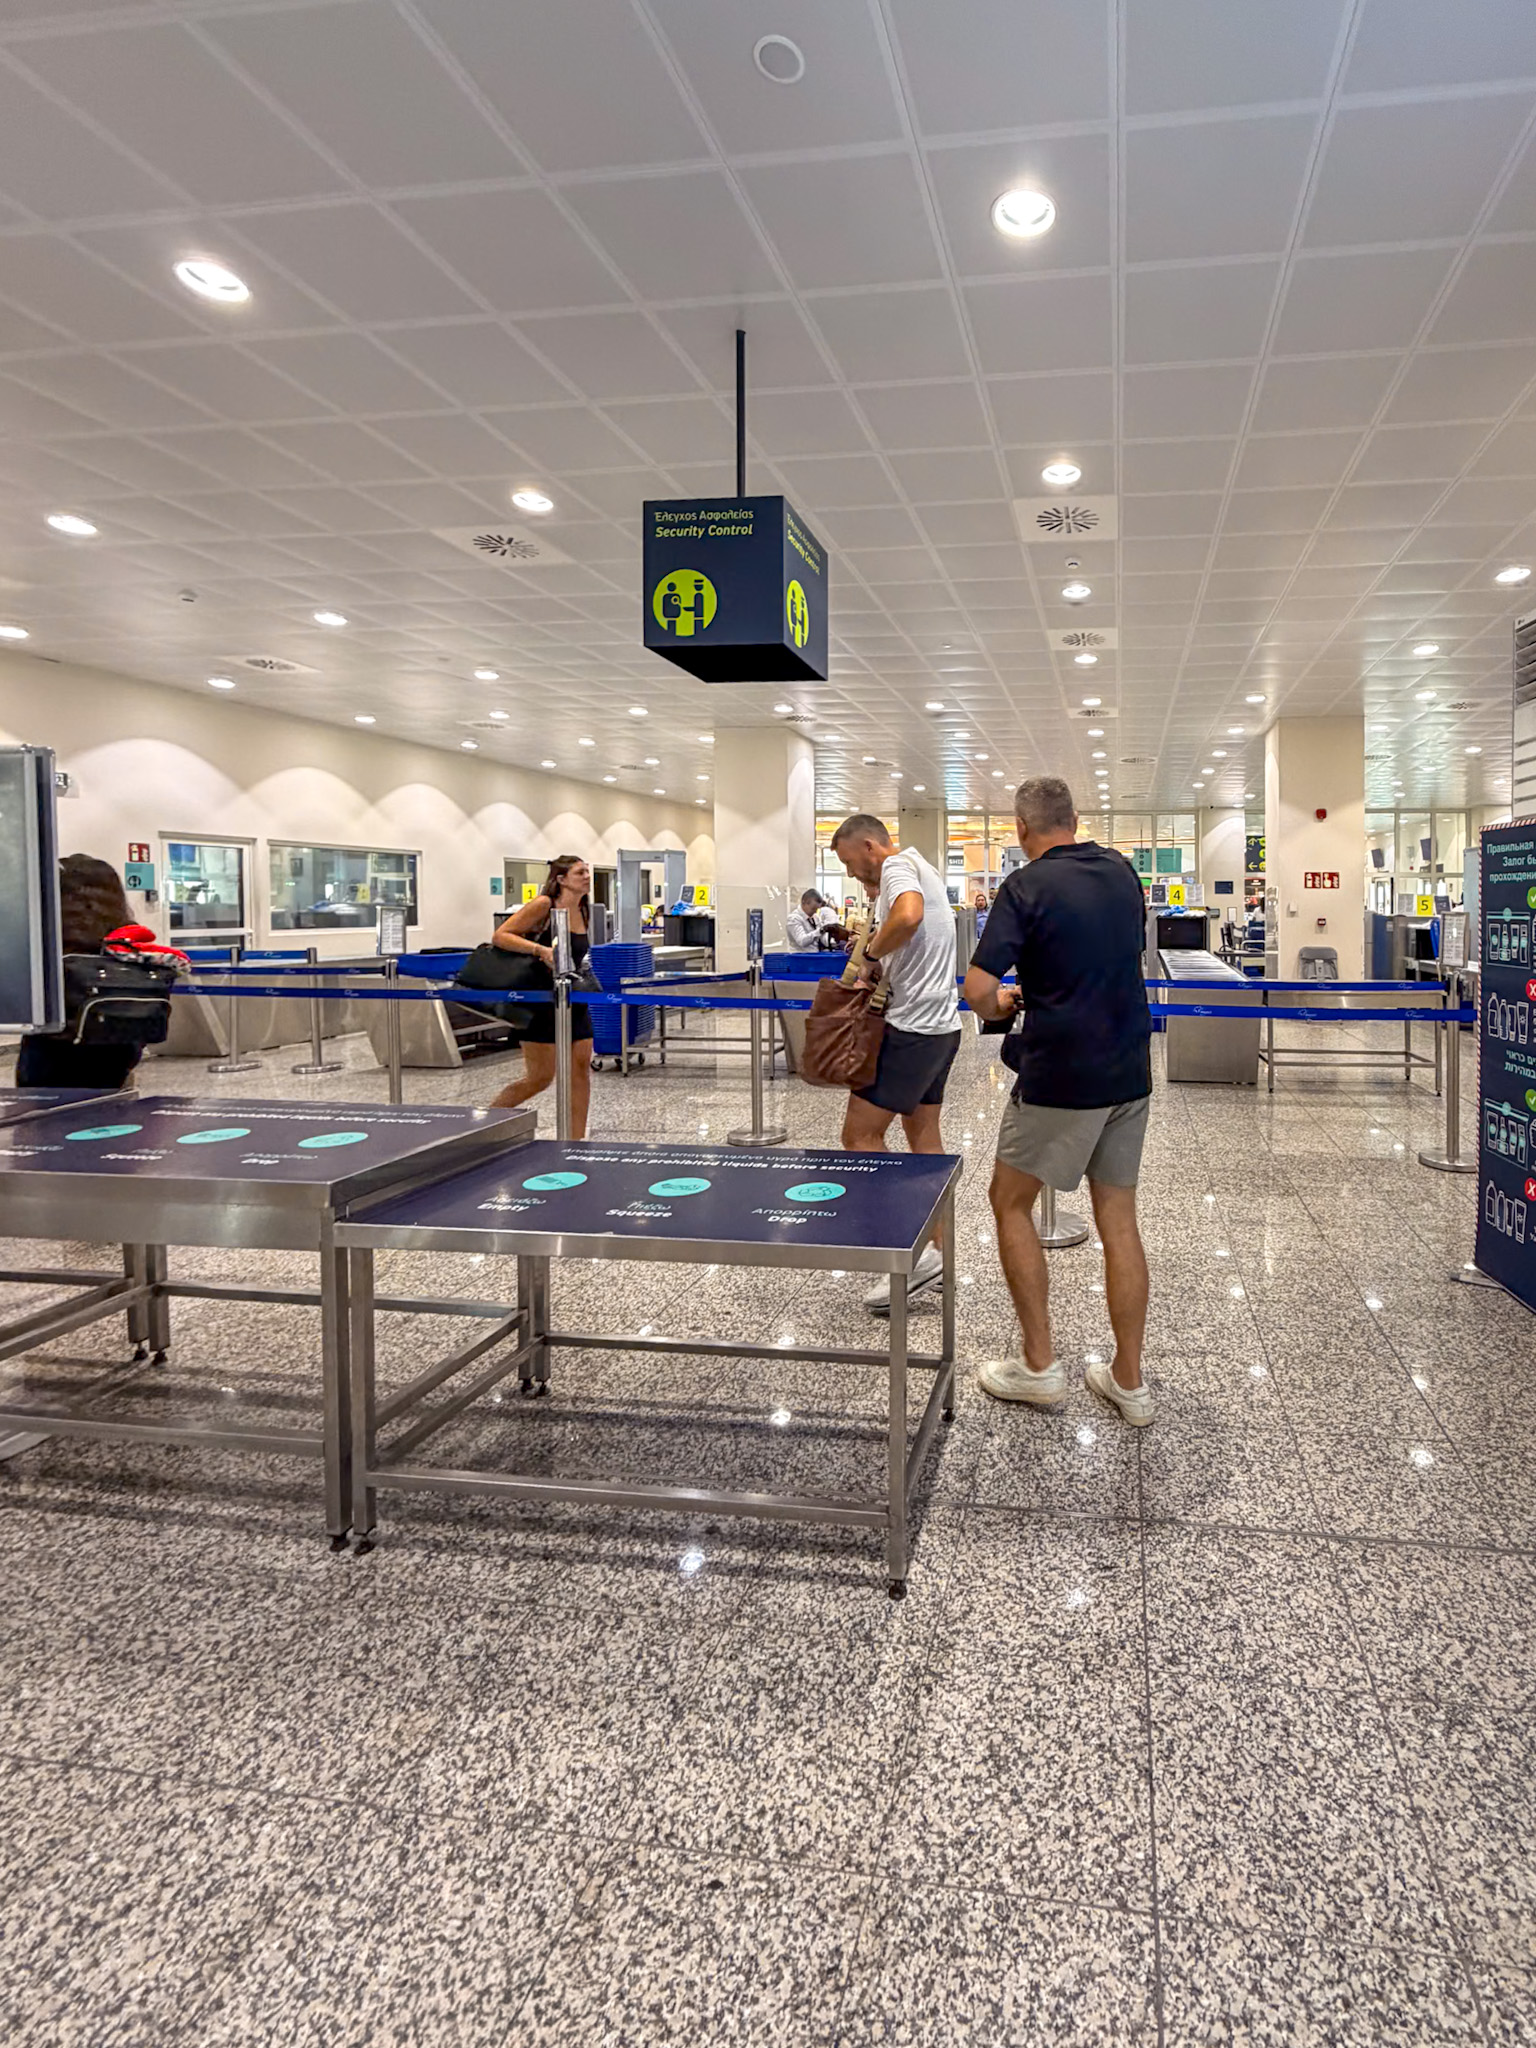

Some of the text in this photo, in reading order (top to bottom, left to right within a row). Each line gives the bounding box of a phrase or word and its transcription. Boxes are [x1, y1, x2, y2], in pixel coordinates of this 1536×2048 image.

[655, 509, 754, 523] Έλεγχος Ασφαλείας
[655, 524, 753, 539] Security Control
[787, 529, 805, 559] Security
[1487, 841, 1535, 855] Правильная
[1503, 855, 1525, 867] Залог
[527, 889, 533, 899] 1
[699, 889, 706, 900] 2
[1173, 889, 1181, 901] 4
[1420, 899, 1429, 911] 5
[648, 1158, 720, 1167] prohibited
[722, 1161, 768, 1169] liquids
[820, 1165, 878, 1173] security
[477, 1203, 530, 1212] Empty
[606, 1209, 673, 1218] Squeeze
[767, 1215, 808, 1225] Drop
